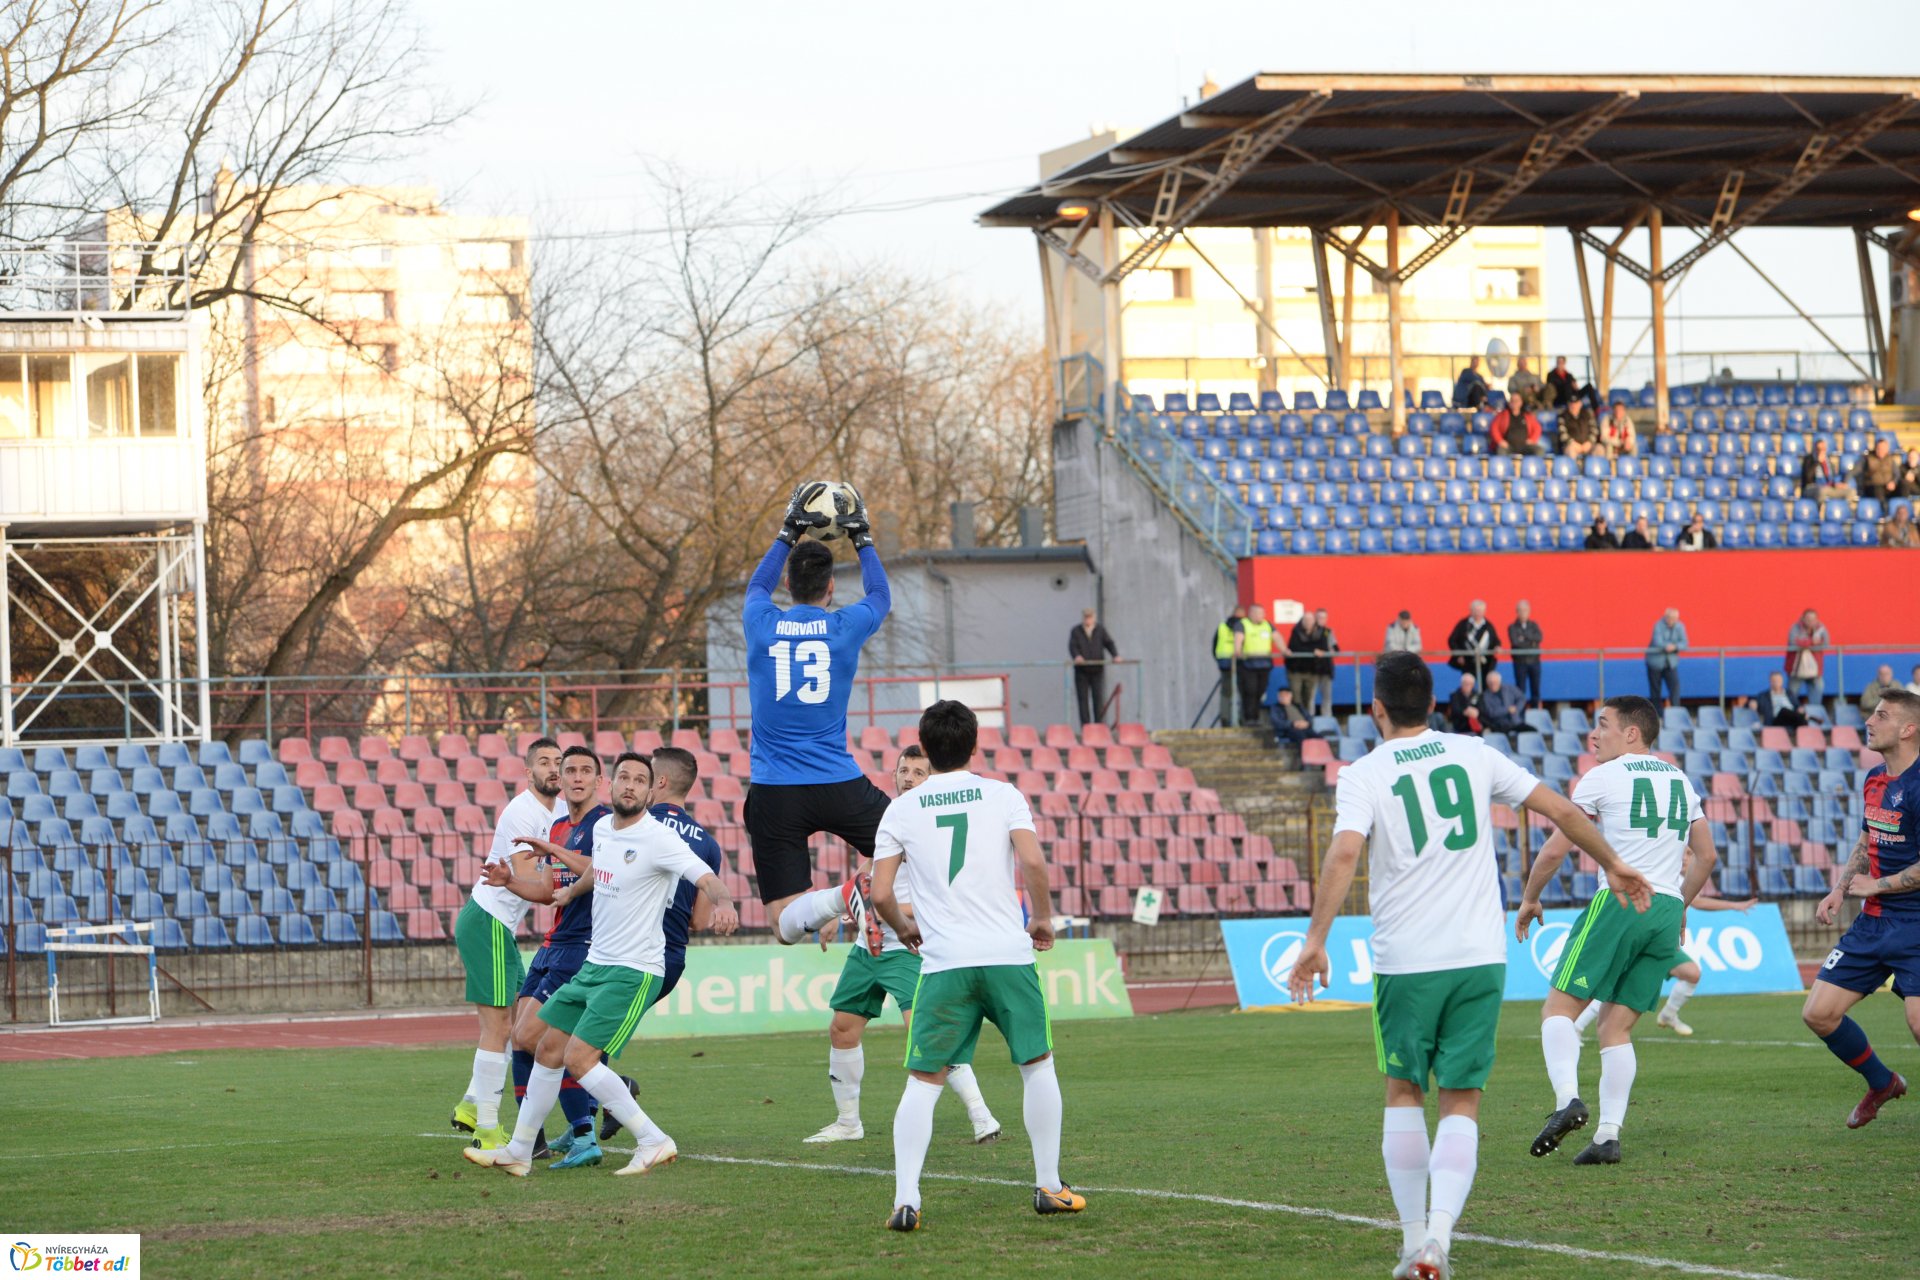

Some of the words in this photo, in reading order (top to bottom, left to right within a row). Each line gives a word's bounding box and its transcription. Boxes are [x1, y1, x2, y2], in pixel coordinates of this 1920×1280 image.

[776, 620, 827, 635] HORVATH
[768, 640, 831, 704] 13
[1393, 742, 1446, 765] ANDRIC
[919, 788, 983, 808] VASHKEBA
[1391, 764, 1478, 858] 19
[1630, 777, 1690, 841] 44
[936, 812, 968, 887] 7
[1044, 952, 1120, 1006] nk
[1347, 938, 1373, 985] J
[1678, 926, 1763, 972] KO
